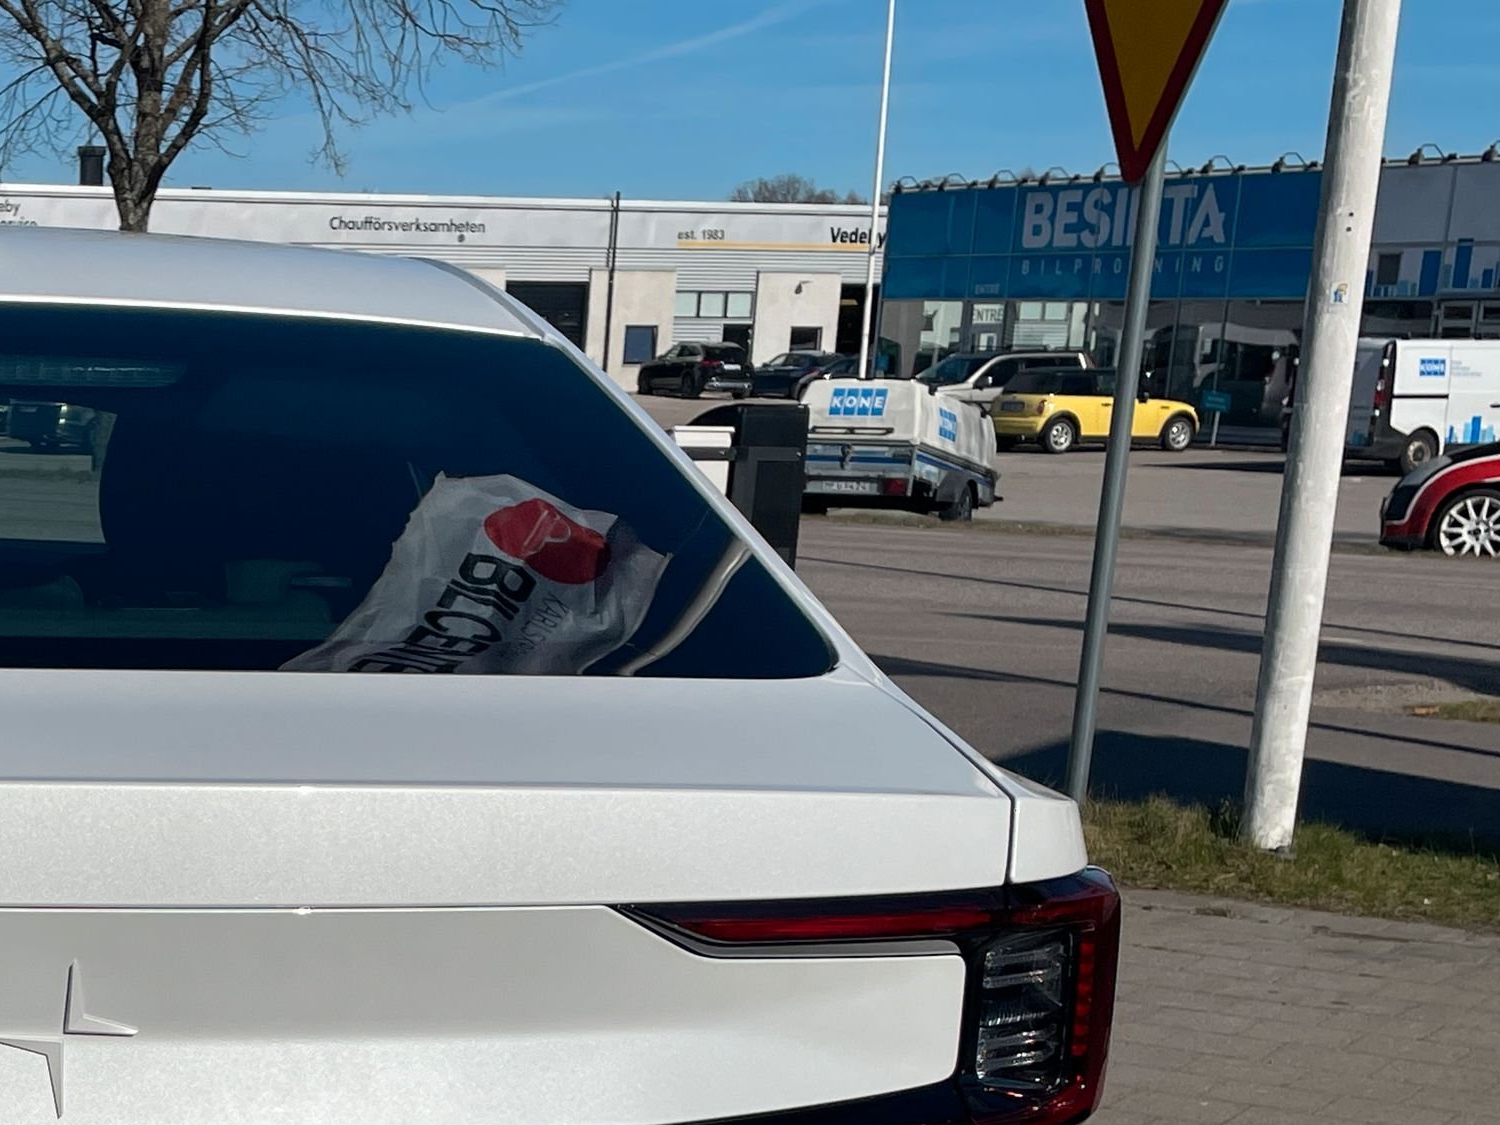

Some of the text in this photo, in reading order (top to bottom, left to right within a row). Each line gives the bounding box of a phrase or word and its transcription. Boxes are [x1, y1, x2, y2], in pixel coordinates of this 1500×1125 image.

[329, 216, 486, 233] Chaufförsverksamheten
[677, 229, 725, 241] est. 1983
[1021, 255, 1225, 275] BILPRONING
[831, 396, 885, 409] KONE
